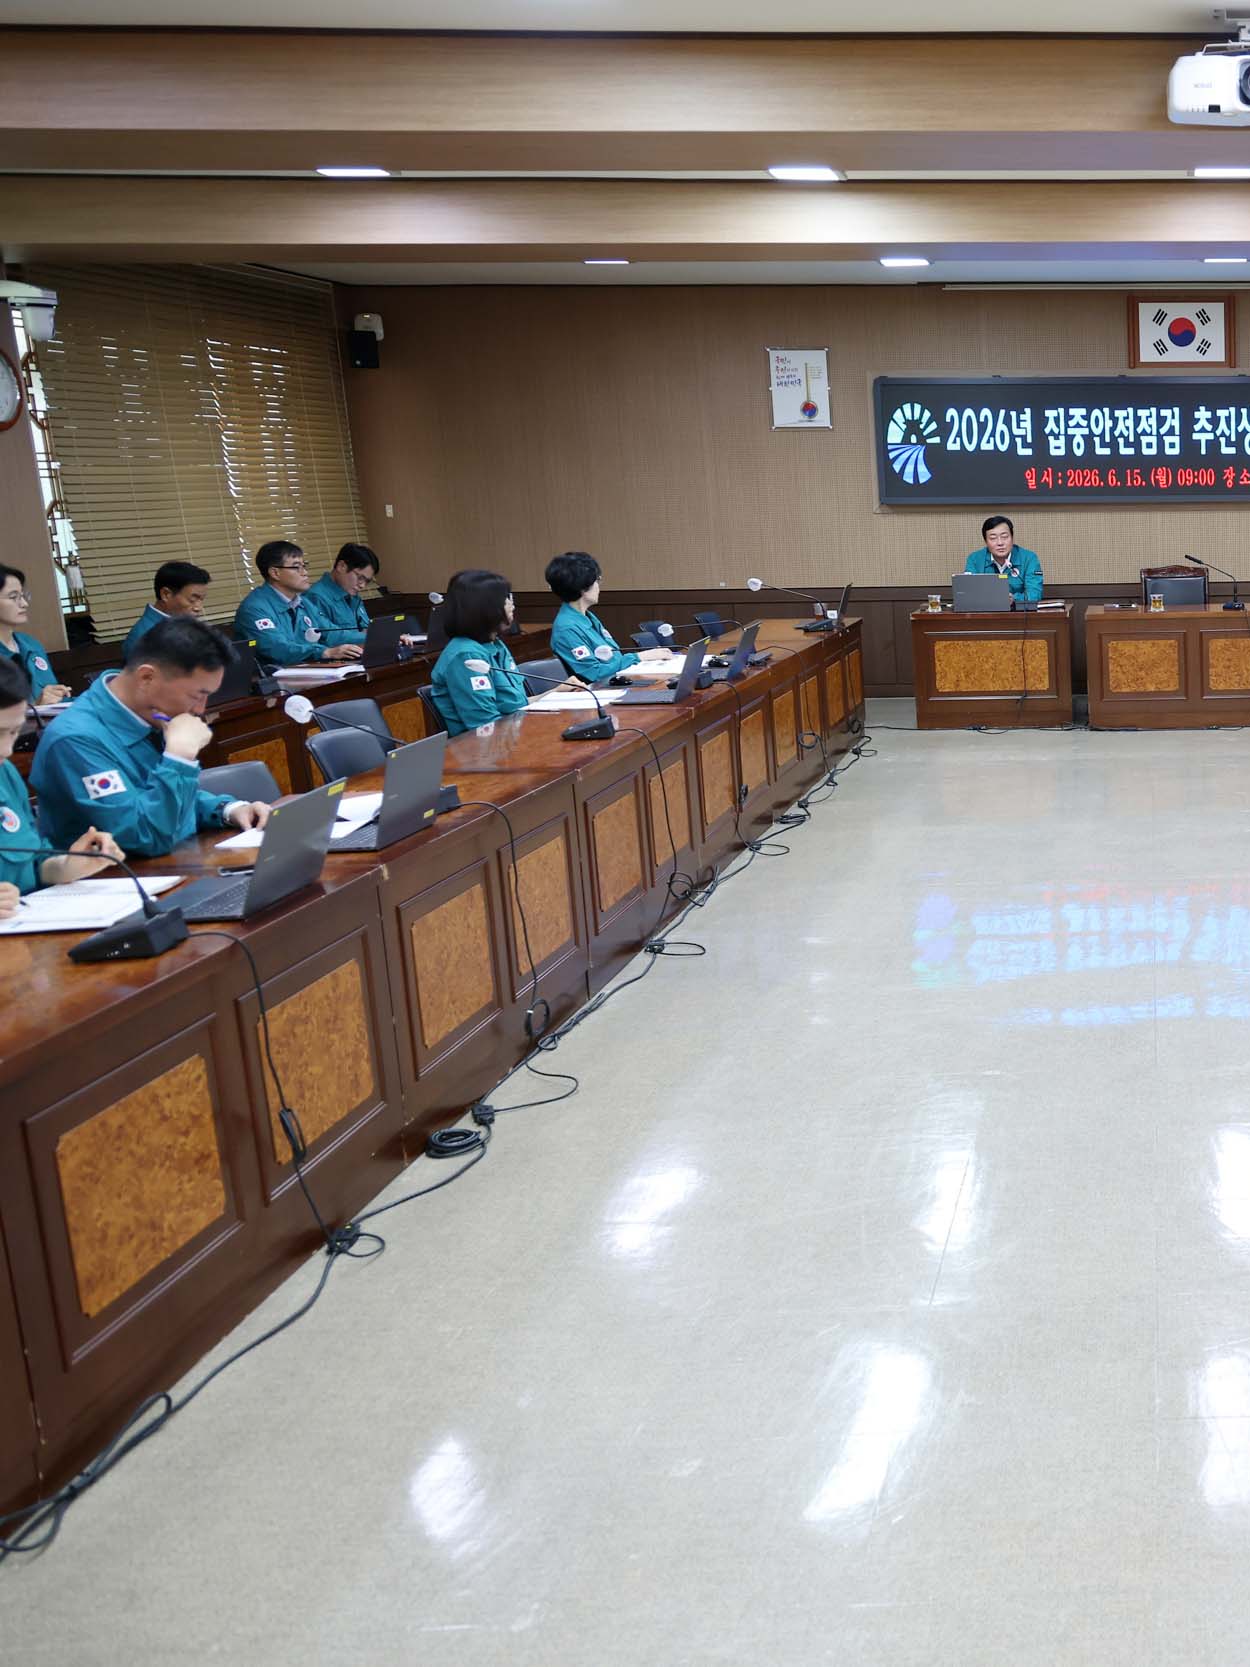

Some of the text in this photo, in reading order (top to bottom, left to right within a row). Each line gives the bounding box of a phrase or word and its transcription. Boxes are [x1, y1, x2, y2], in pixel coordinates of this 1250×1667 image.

[945, 407, 1033, 456] 2026년
[1044, 407, 1181, 456] 집중안전점검
[1067, 469, 1104, 487] 2026.
[1177, 469, 1216, 487] 09:00
